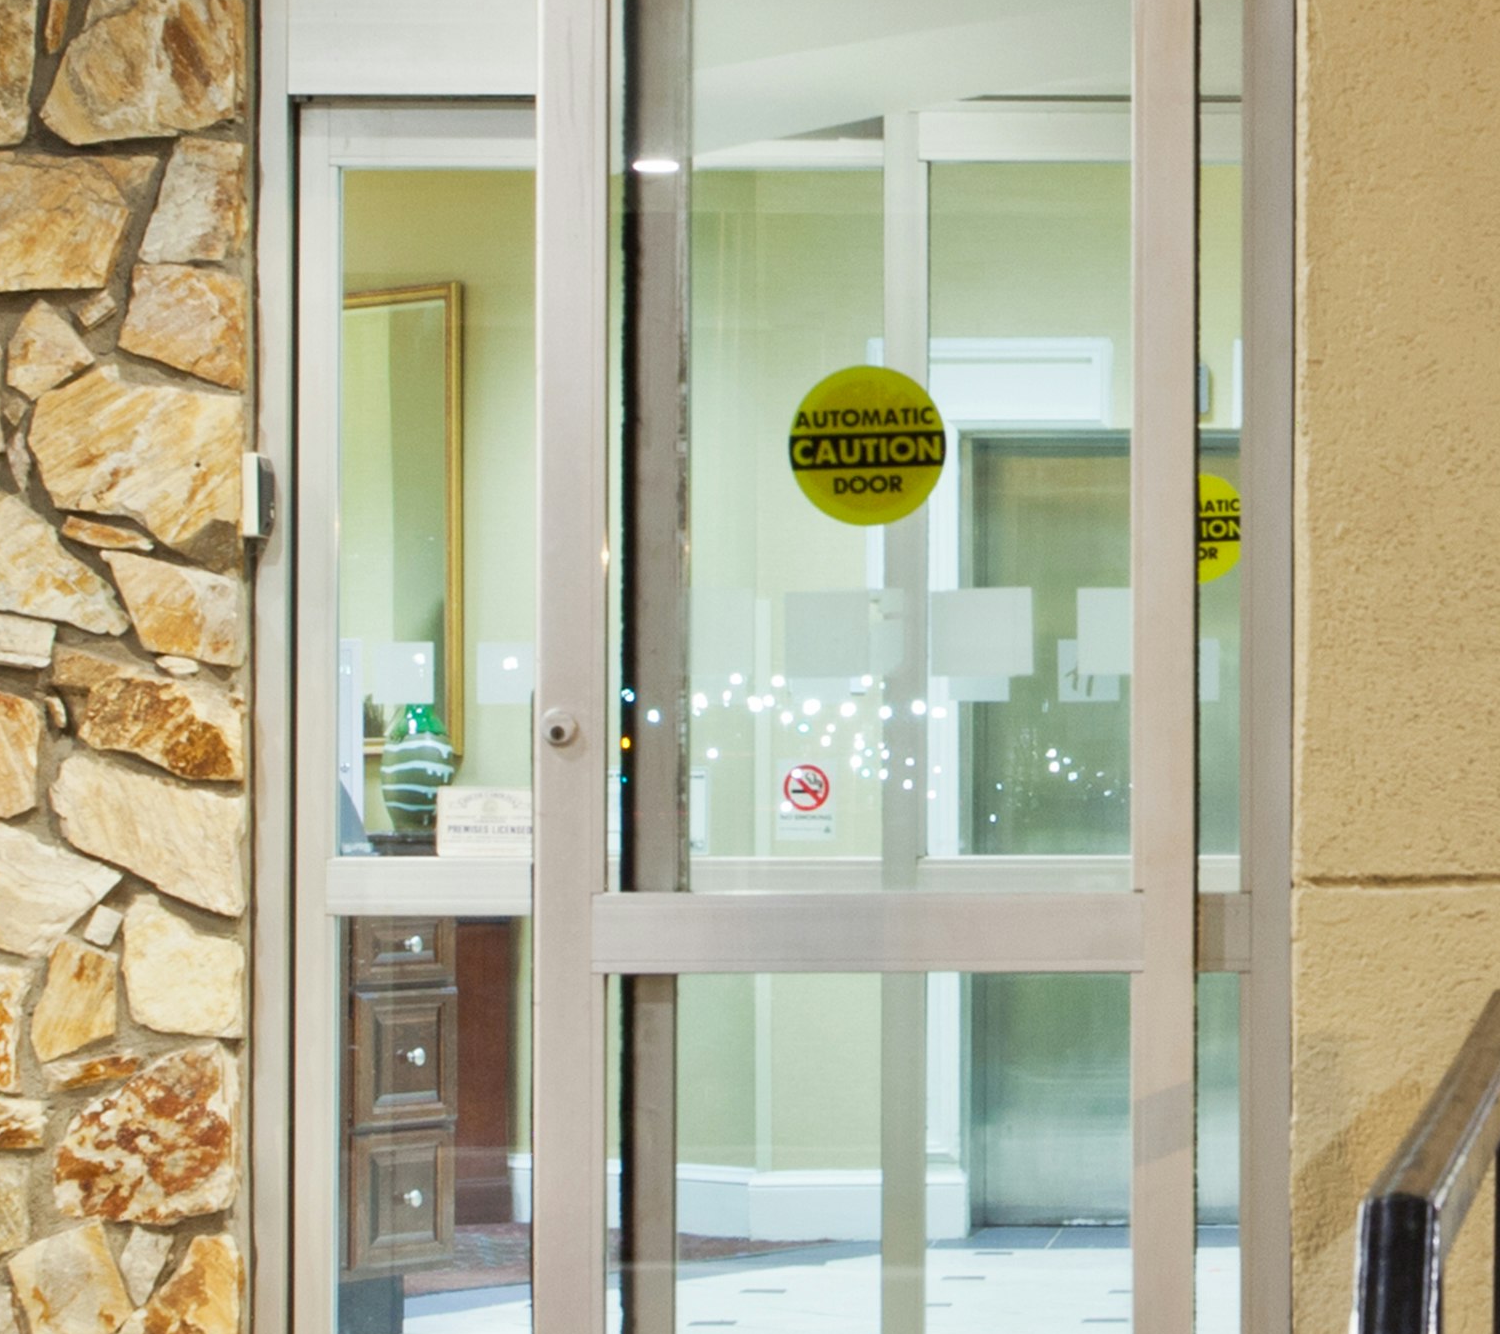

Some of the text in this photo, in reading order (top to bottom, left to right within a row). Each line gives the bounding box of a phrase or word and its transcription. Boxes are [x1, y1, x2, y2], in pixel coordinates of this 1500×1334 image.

[795, 406, 934, 430] AUTOMATIC
[792, 435, 942, 466] CAUTION
[833, 475, 904, 495] DOOR
[448, 825, 489, 834] PREMISES
